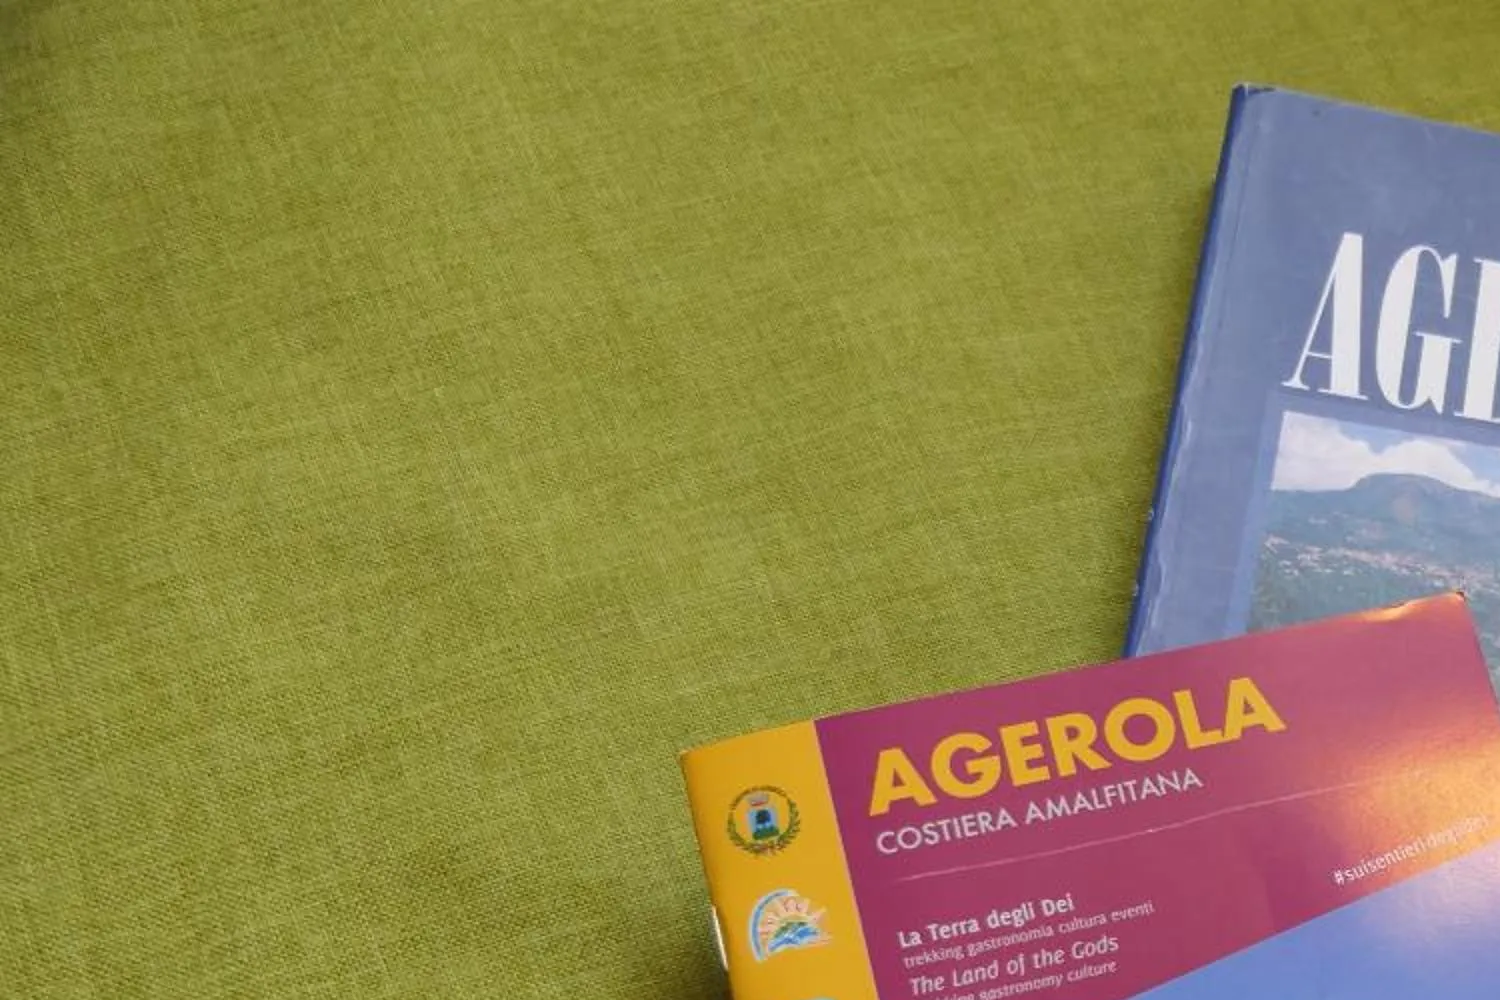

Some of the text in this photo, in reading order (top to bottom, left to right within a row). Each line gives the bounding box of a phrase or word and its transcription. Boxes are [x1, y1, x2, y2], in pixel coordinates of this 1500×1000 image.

[869, 676, 1287, 817] AGEROLA
[876, 767, 1204, 856] COSTIERA AMALFITANA
[898, 892, 1074, 948] La Terra degli Dei
[903, 900, 1156, 969] trekking gastronomia cultura eventi
[909, 934, 1120, 996] The Land of the Gods
[1067, 958, 1117, 984] culture
